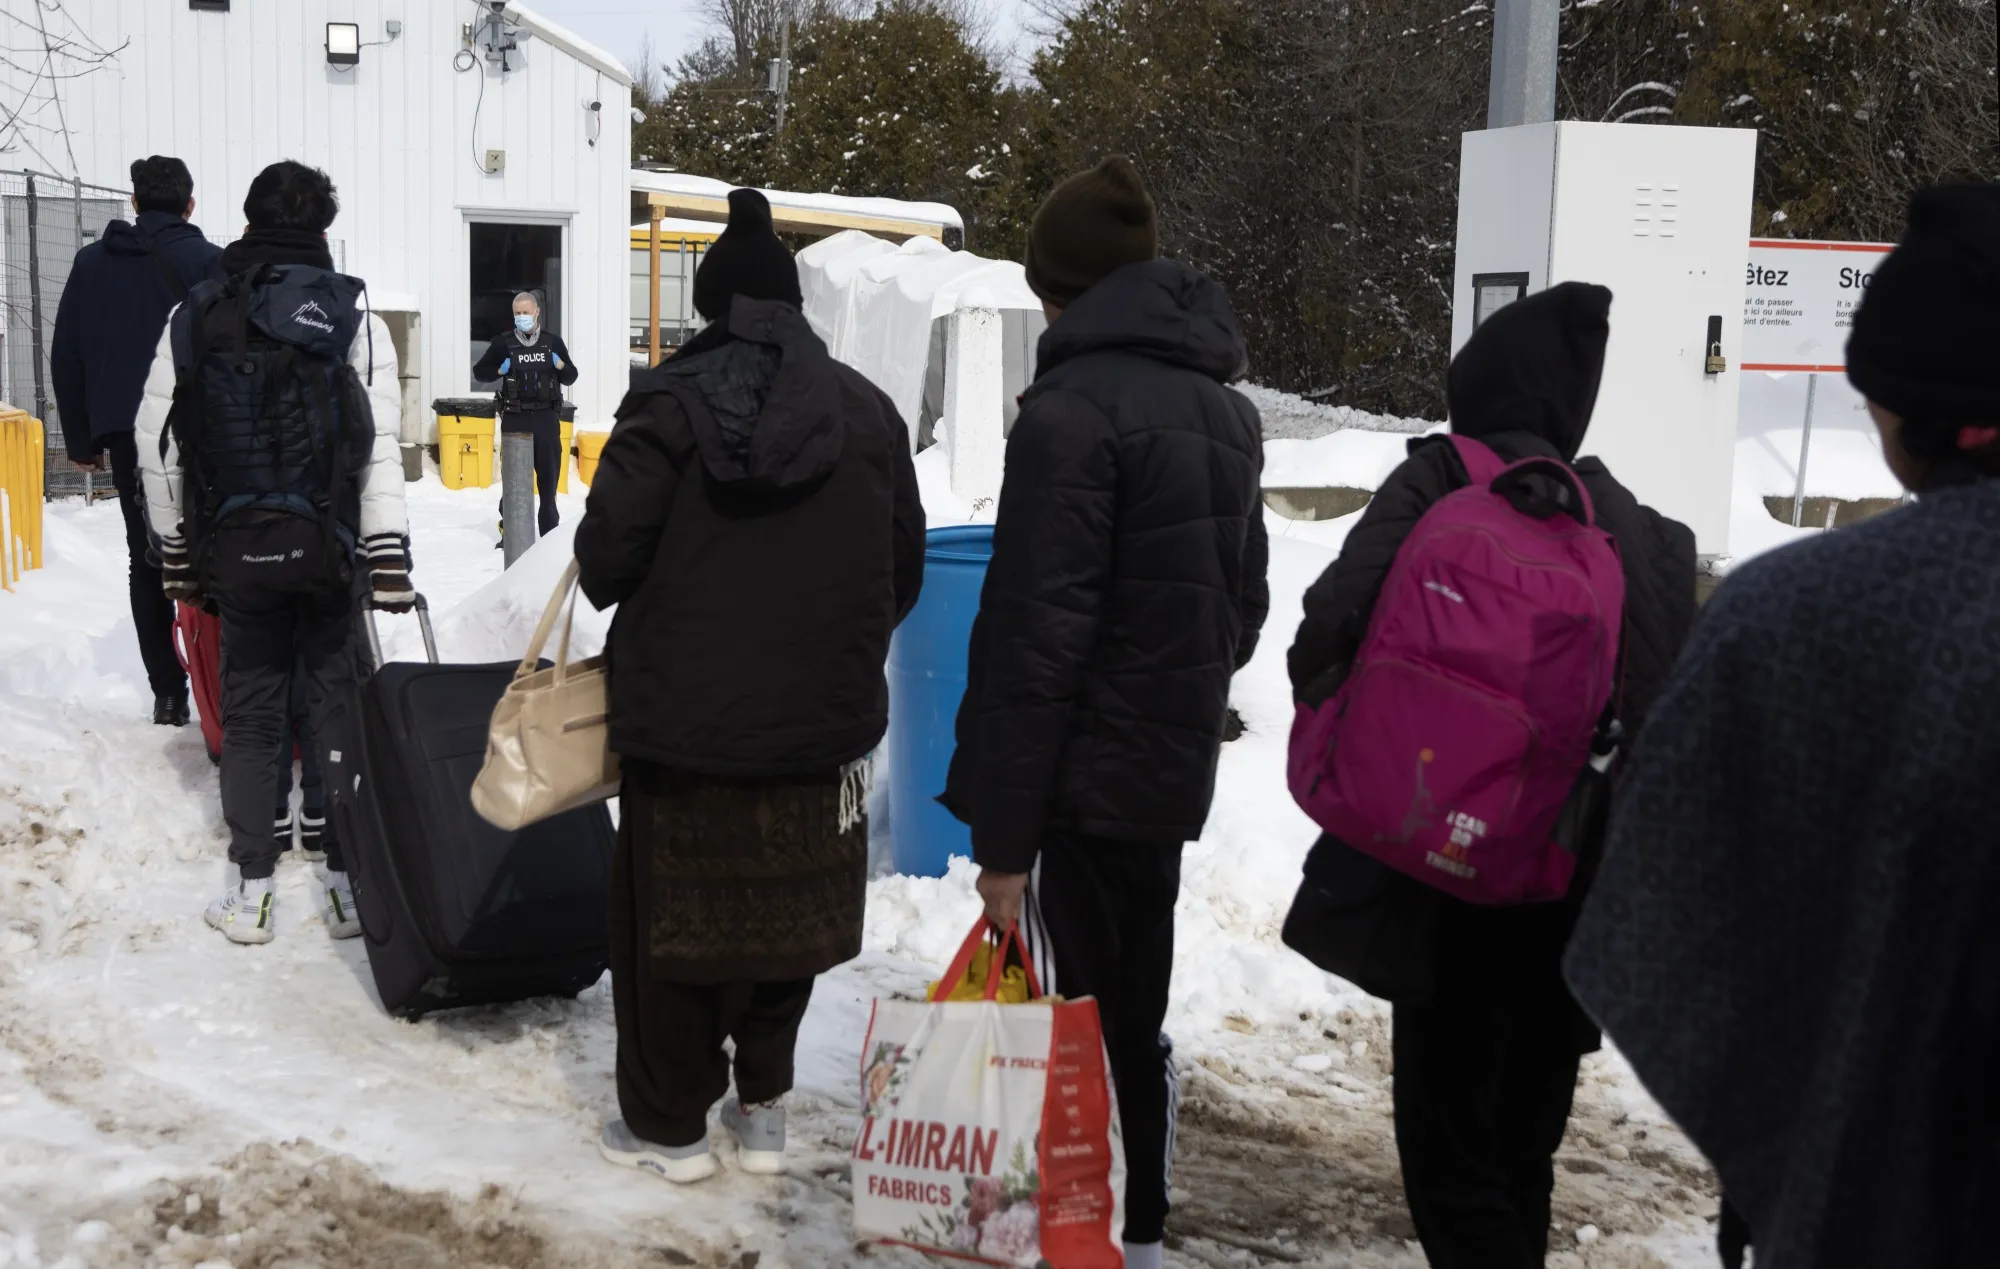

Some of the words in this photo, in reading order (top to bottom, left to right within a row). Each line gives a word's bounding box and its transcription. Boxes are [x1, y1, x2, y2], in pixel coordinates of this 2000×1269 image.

[1754, 297, 1765, 306] de
[1767, 299, 1793, 307] passer
[1836, 299, 1842, 308] It
[1844, 299, 1851, 308] is
[1750, 307, 1760, 316] ici
[1775, 308, 1803, 317] ailleurs
[518, 352, 545, 364] POLICE
[291, 548, 304, 559] 90
[868, 1174, 952, 1207] FABRICS
